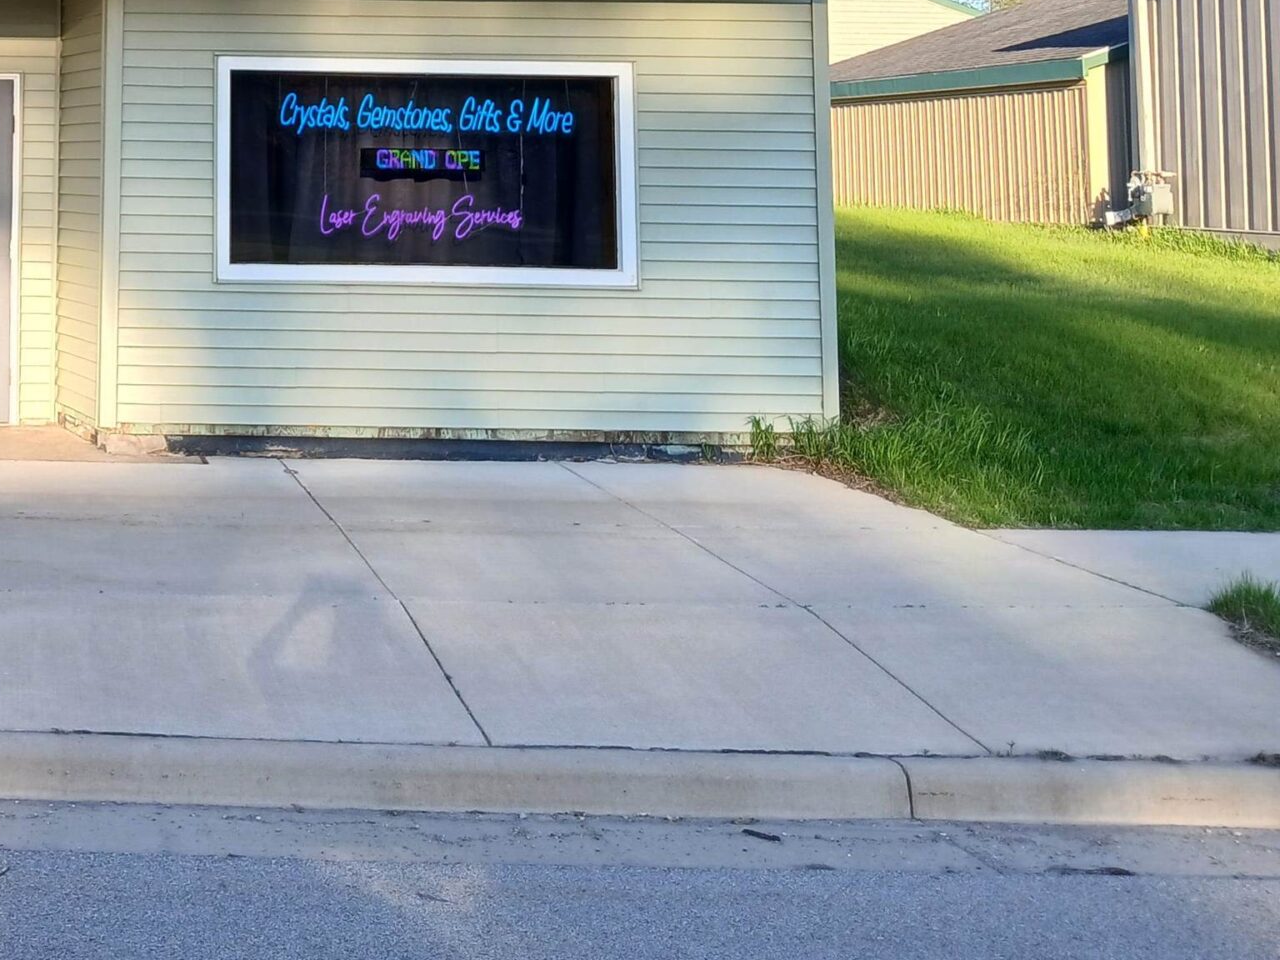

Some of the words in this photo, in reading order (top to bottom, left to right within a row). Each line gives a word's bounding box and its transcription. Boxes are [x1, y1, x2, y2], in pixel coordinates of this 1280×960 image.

[280, 92, 350, 135] Crystals,
[357, 93, 452, 132] Gemstones,
[459, 96, 502, 132] Gifts
[507, 99, 524, 132] &
[526, 97, 573, 134] More
[376, 149, 436, 169] GRAND
[445, 150, 481, 169] OPE
[320, 194, 356, 235] Laser
[361, 193, 446, 241] Engraving
[452, 194, 522, 239] Services
